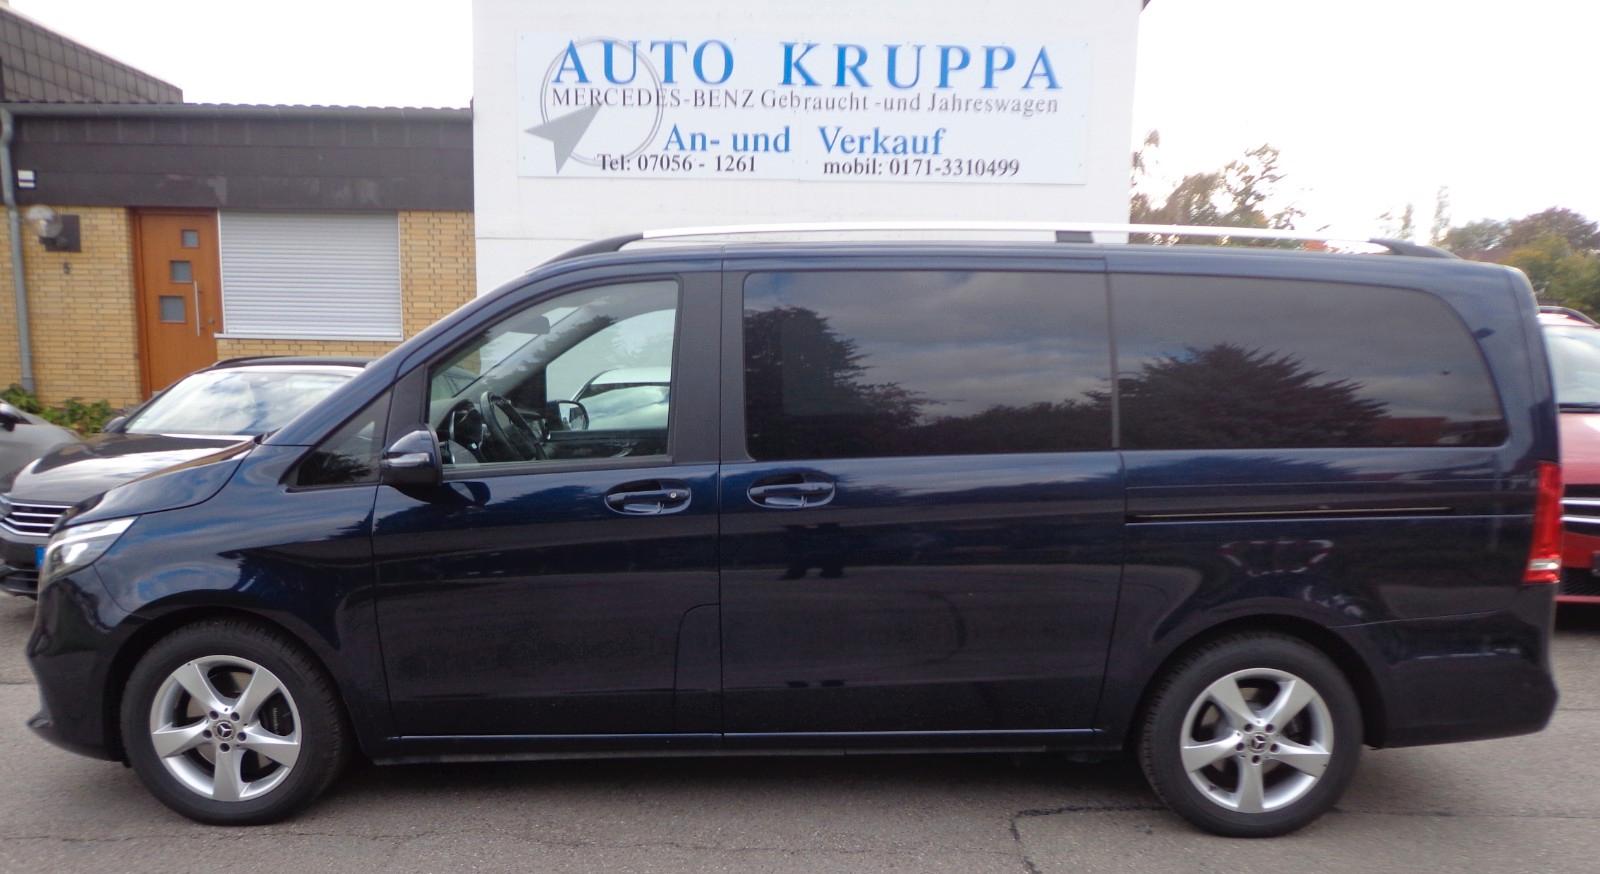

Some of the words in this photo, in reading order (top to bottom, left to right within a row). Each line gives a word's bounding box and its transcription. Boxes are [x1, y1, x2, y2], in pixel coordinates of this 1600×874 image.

[551, 39, 734, 85] AUTO
[778, 41, 1063, 90] KRUPPA
[551, 87, 755, 108] MERCEDES-BENZ
[761, 89, 868, 111] Gebraucht
[927, 93, 1059, 117] Jahreswagen
[663, 123, 720, 152] An-
[731, 125, 791, 153] und
[818, 126, 946, 156] Verkauf
[597, 154, 631, 172] Tel:
[637, 154, 693, 172] 07056
[715, 155, 757, 173] 1261
[823, 158, 883, 175] mobil:
[889, 158, 1020, 177] 0171-3310499
